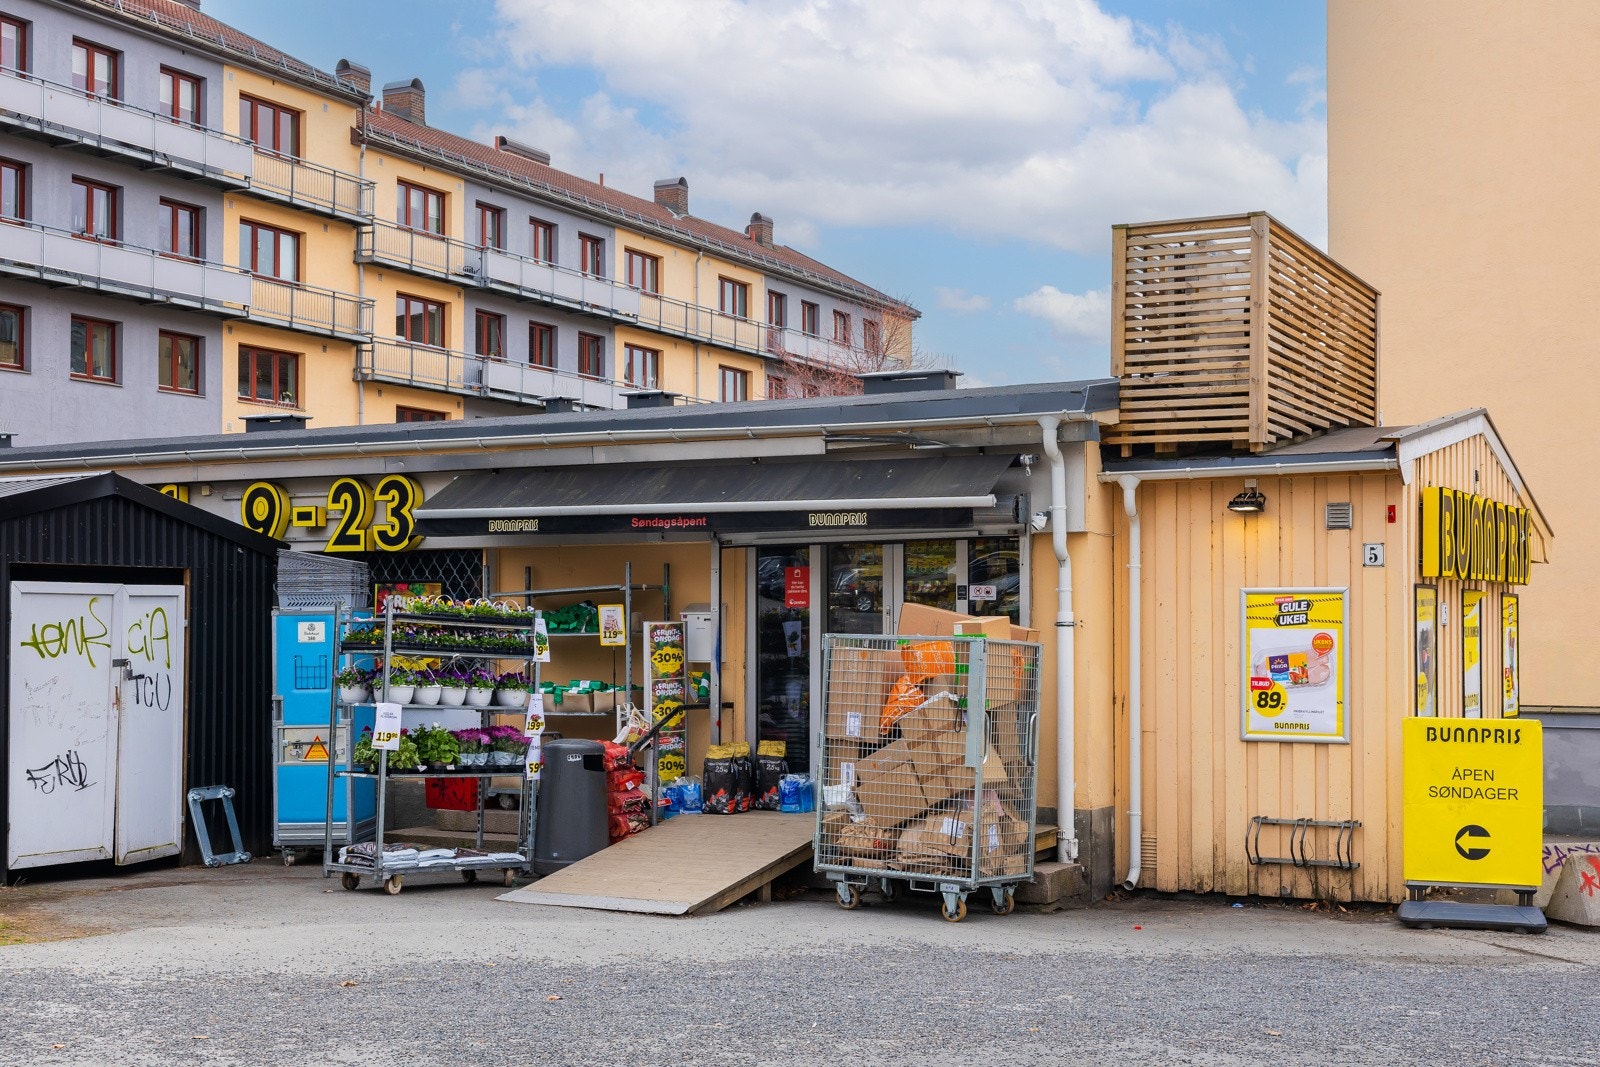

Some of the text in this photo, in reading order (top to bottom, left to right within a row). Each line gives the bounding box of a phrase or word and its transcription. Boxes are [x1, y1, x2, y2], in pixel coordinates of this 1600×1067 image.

[241, 475, 421, 553] 9-23
[808, 512, 868, 527] BUNNPRIS
[488, 519, 539, 533] BUNNPRIS
[631, 516, 707, 531] Søndagsåpent
[1441, 487, 1532, 586] BUNNPRIS
[1368, 547, 1379, 564] 5
[1281, 601, 1307, 612] GULE
[1280, 614, 1306, 625] UKER
[653, 635, 680, 643] ONSDAG
[656, 629, 676, 637] FRUKT
[653, 653, 683, 663] -30%
[655, 688, 682, 696] ONSDAG
[1257, 691, 1286, 710] 89,-
[1274, 722, 1310, 730] BUNNPRIS
[1426, 726, 1522, 744] BUNNPRIS
[1451, 766, 1495, 781] ÅPEN
[1428, 786, 1519, 800] SØNDAGER
